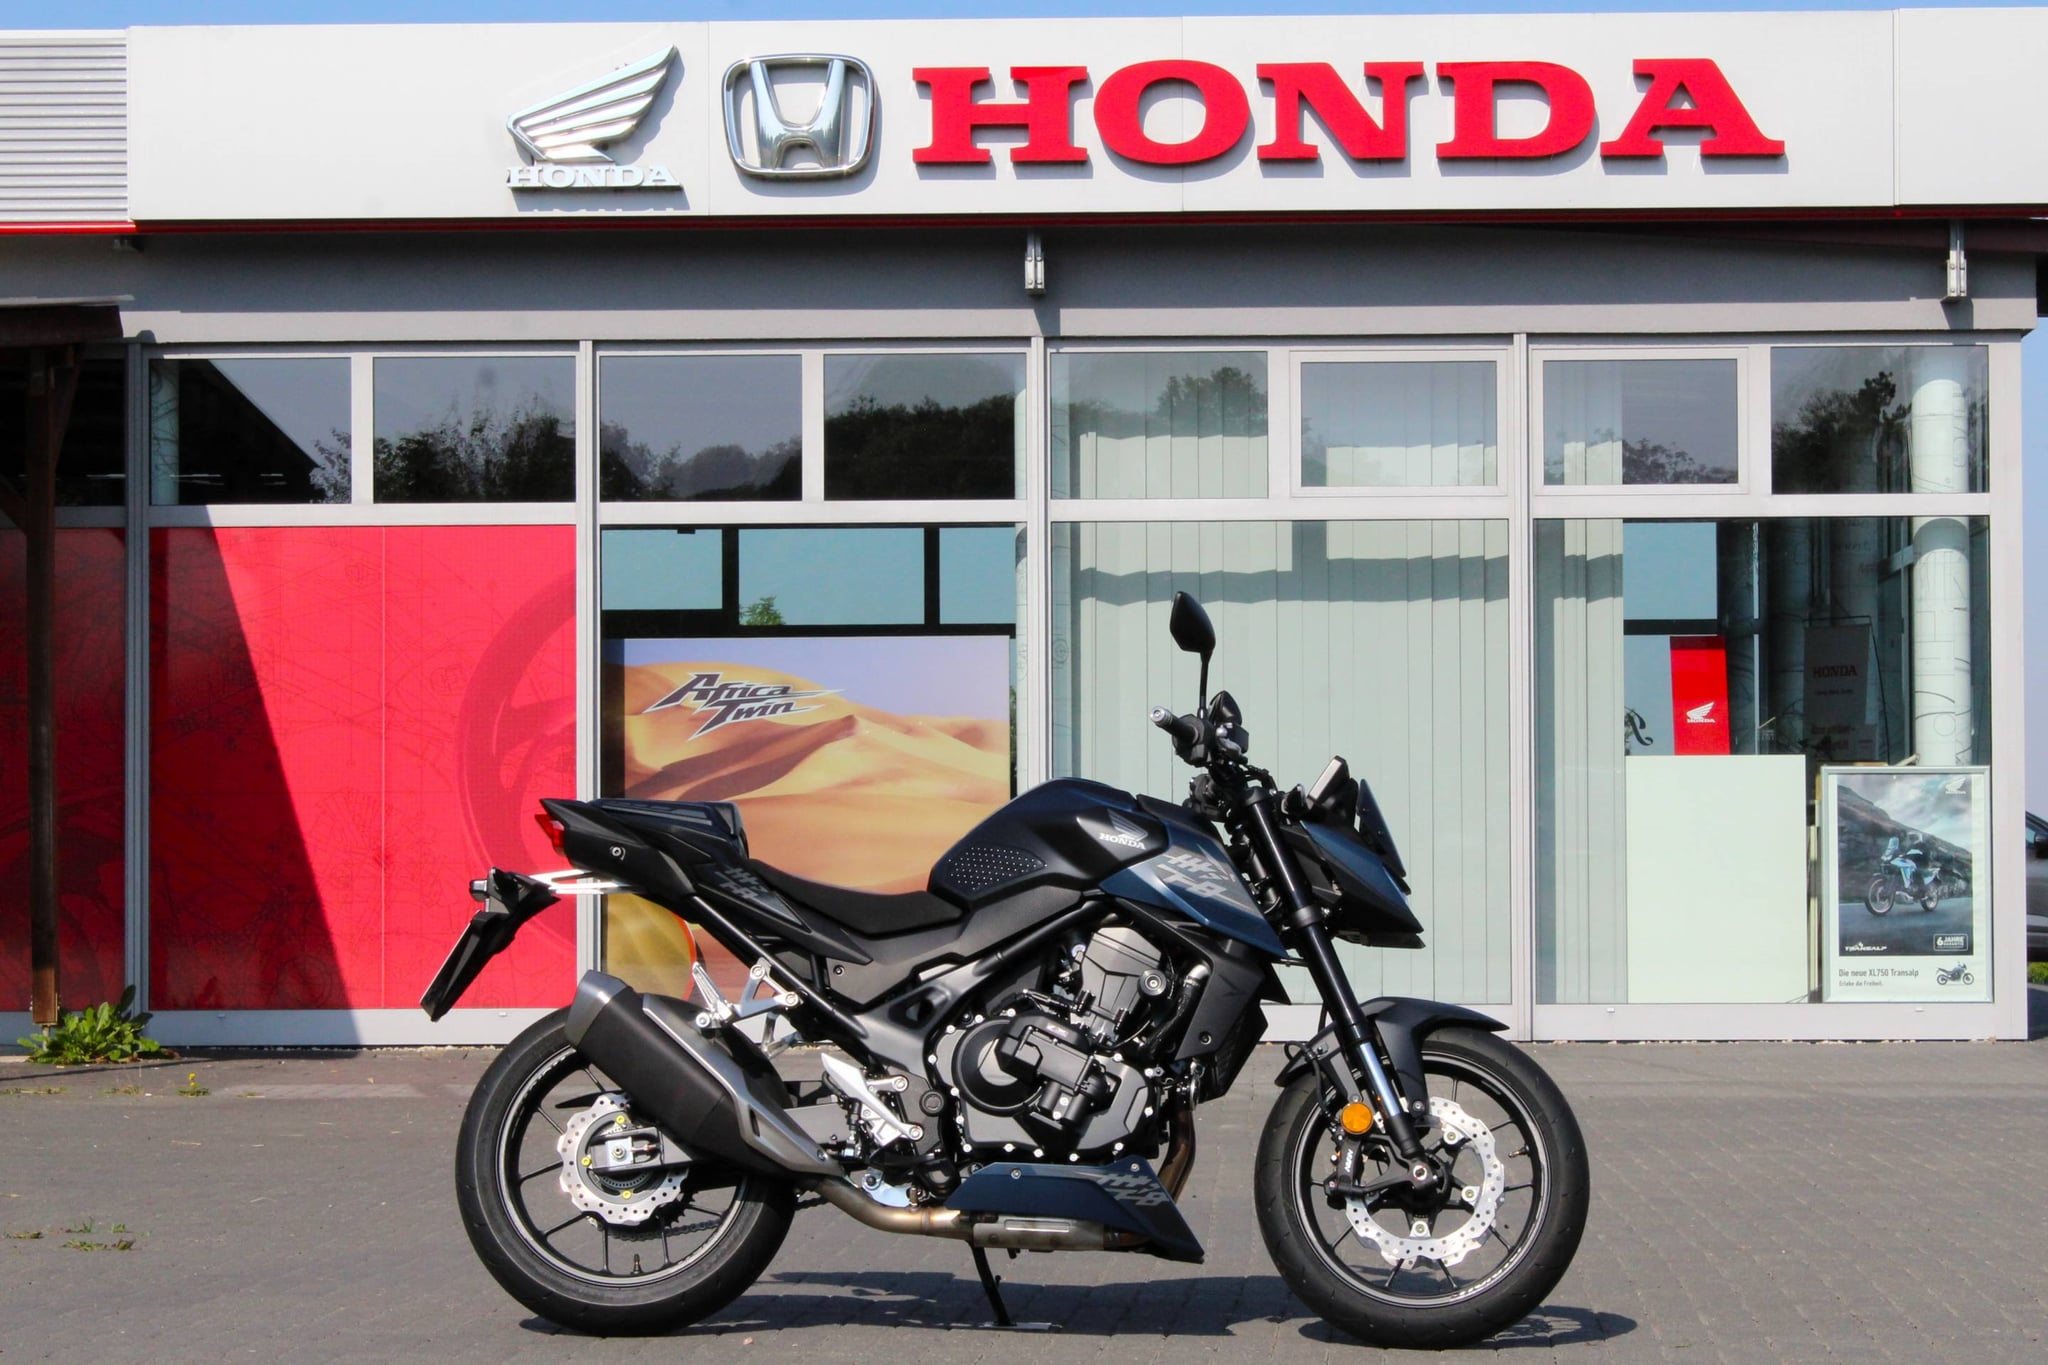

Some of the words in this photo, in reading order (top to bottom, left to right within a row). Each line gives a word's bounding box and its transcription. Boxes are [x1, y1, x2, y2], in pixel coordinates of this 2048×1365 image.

[913, 59, 1785, 164] HONDA
[506, 164, 682, 187] HONDA
[1813, 664, 1858, 678] HONDA
[643, 673, 828, 713] Africa
[688, 700, 815, 741] Twin
[1099, 832, 1146, 850] HONDA
[1936, 936, 1944, 946] 6
[1838, 968, 1849, 977] Die
[1868, 968, 1889, 977] XL750
[1891, 968, 1919, 978] Transalp
